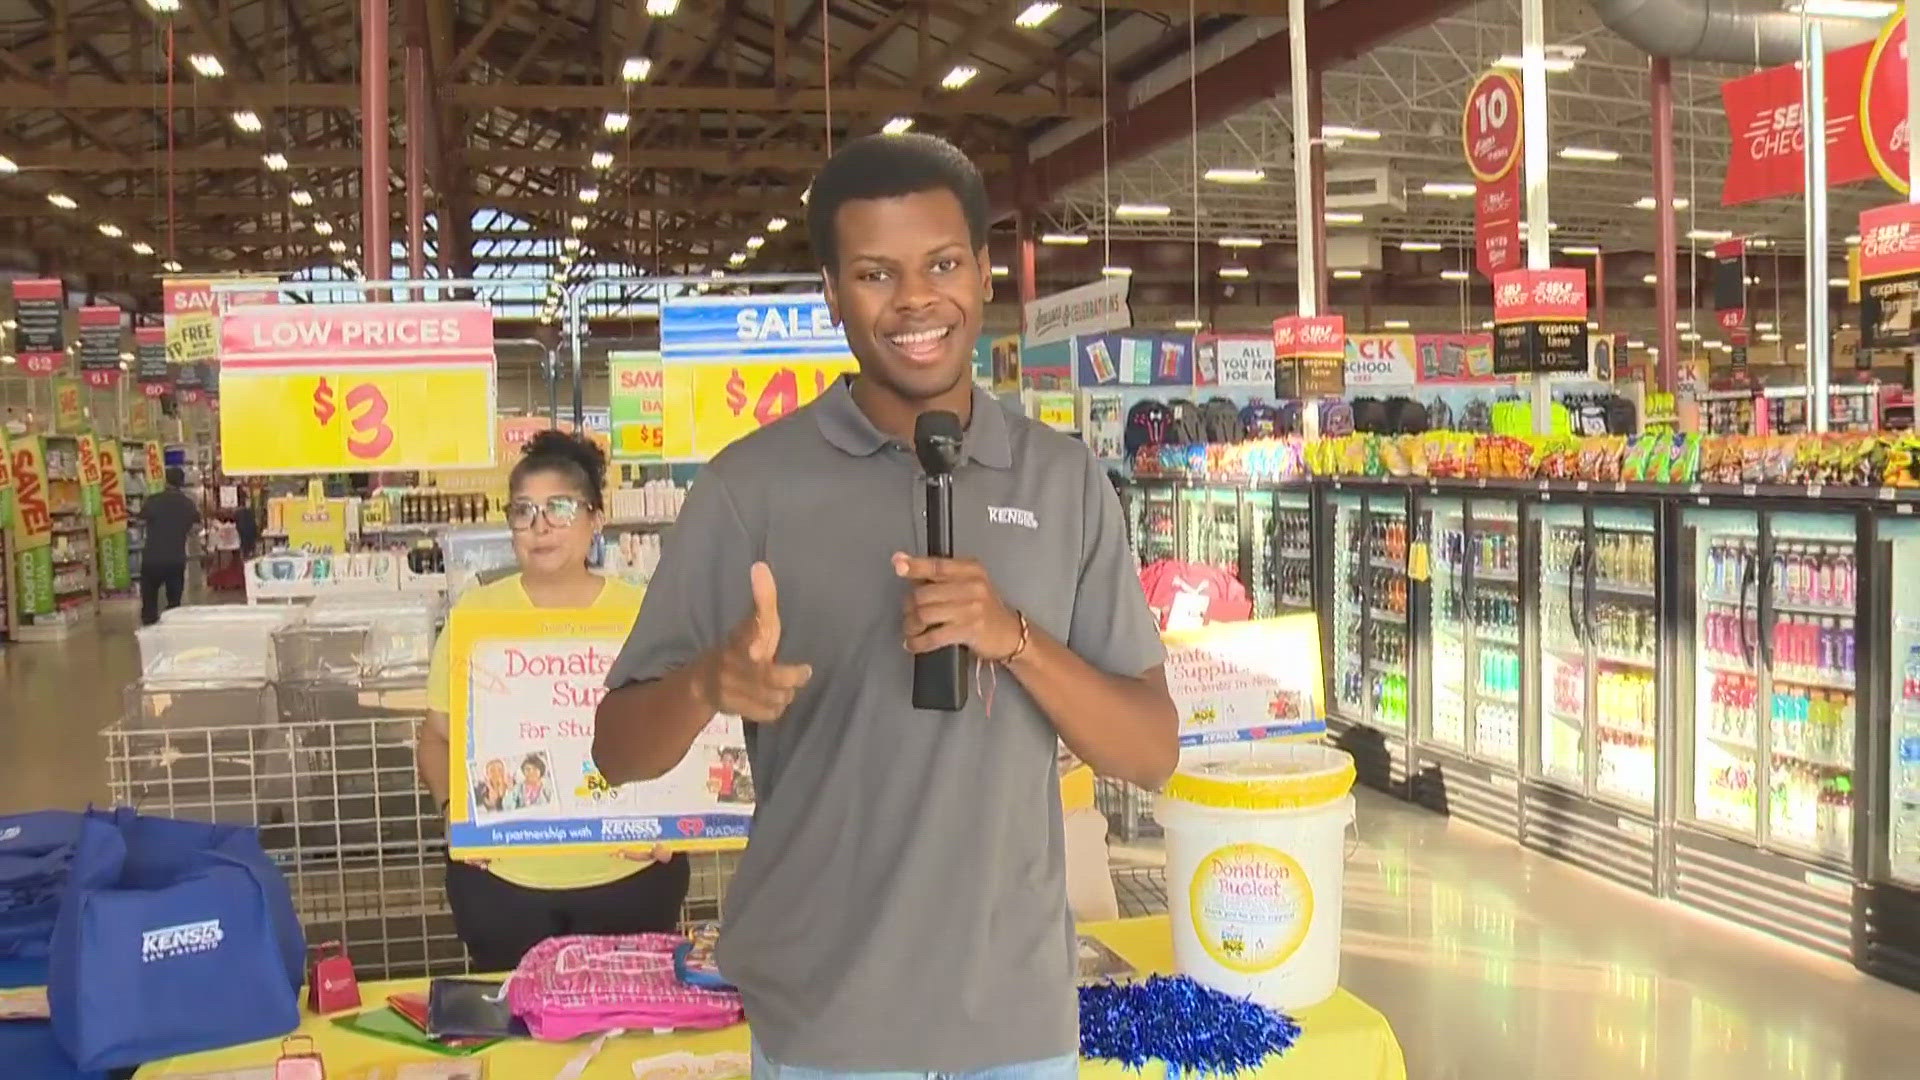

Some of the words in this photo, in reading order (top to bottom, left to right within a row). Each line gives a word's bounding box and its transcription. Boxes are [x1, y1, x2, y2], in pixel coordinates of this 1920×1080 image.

[1475, 88, 1508, 133] 10
[1865, 239, 1905, 258] CHECK
[737, 306, 844, 339] SALE
[1722, 312, 1738, 327] 43
[181, 323, 214, 343] FREE
[253, 320, 333, 348] LOW
[342, 319, 462, 346] PRICES
[1538, 324, 1580, 337] express
[1547, 335, 1571, 348] lane
[1242, 348, 1262, 358] ALL
[1540, 353, 1557, 366] 10
[28, 356, 51, 372] 62
[1223, 360, 1248, 370] YOU
[91, 374, 110, 386] 61
[1226, 372, 1248, 381] FOR
[13, 448, 52, 536] SAVE!
[101, 451, 129, 524] SAVE!
[520, 722, 550, 738] For
[505, 826, 566, 845] partnership
[570, 825, 592, 840] with
[1211, 858, 1290, 880] Donation
[1219, 879, 1281, 897] Bucket
[142, 919, 224, 954] KENS5
